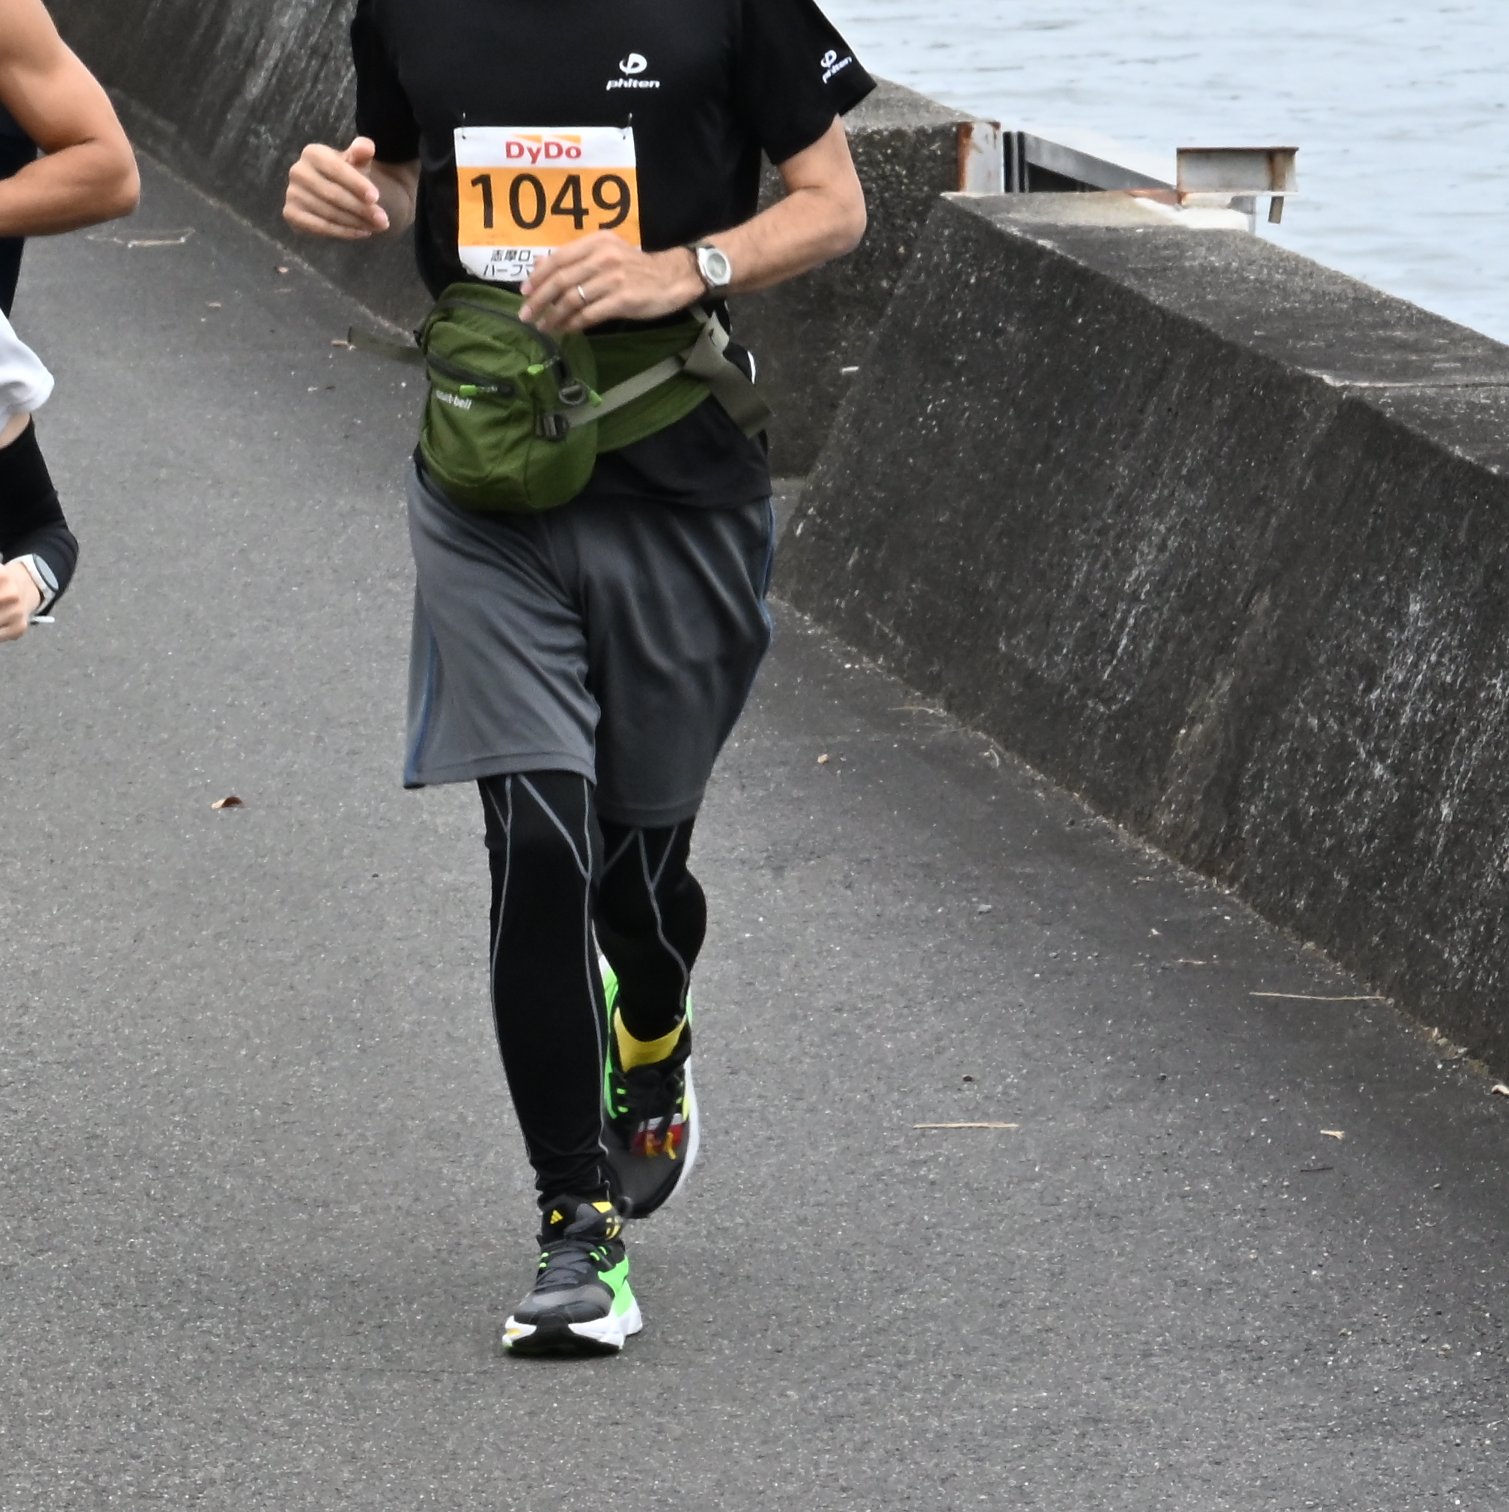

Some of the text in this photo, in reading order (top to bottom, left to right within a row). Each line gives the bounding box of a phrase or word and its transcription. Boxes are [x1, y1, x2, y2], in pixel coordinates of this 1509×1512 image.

[606, 79, 660, 90] phiten
[505, 141, 582, 164] DyDo
[471, 173, 631, 230] 1049
